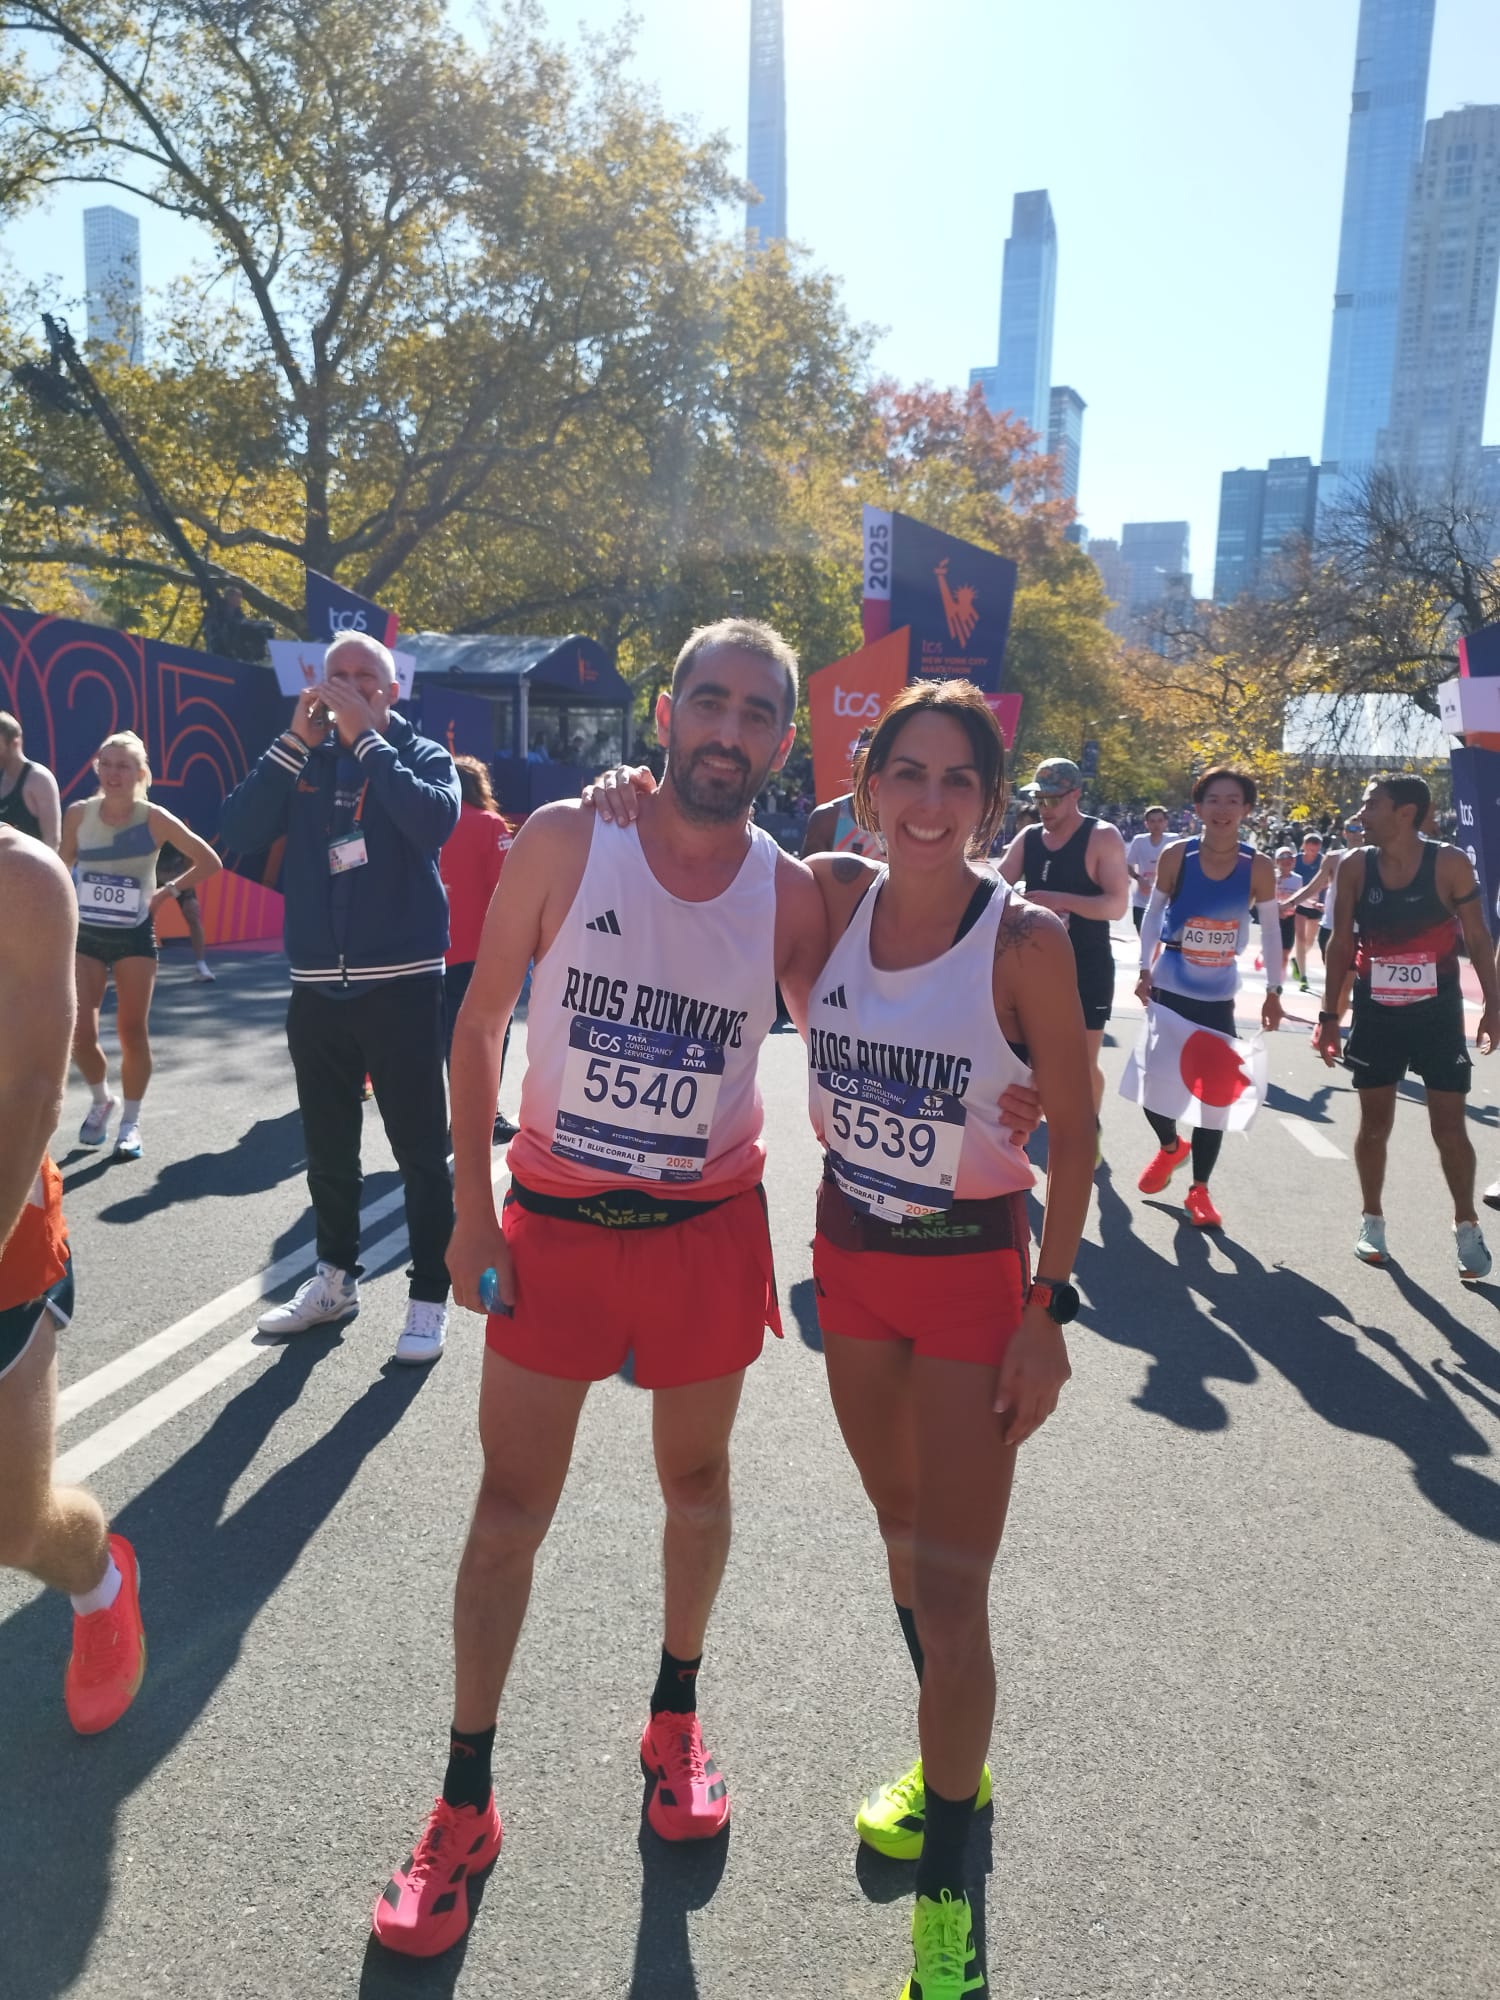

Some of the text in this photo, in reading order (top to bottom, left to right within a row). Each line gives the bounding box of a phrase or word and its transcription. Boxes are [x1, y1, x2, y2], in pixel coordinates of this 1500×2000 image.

[868, 524, 889, 590] 2025
[329, 607, 367, 632] tcs
[833, 685, 881, 718] tcs
[1460, 799, 1474, 826] tcs
[94, 886, 126, 904] 608
[1185, 930, 1235, 945] AG 1970
[1387, 965, 1422, 983] 730
[561, 966, 748, 1049] RIOS RUNNING
[588, 1026, 623, 1053] tcs
[624, 1042, 673, 1056] CONSULTANCY
[627, 1034, 647, 1044] TATA
[624, 1049, 655, 1061] SERVICES
[682, 1058, 706, 1068] TATA
[810, 1027, 972, 1099] RIOS RUNNING
[583, 1057, 698, 1119] 5540
[863, 1077, 882, 1088] TATA
[862, 1084, 906, 1105] CONSULTANCY
[862, 1091, 890, 1106] SERVICES
[918, 1107, 944, 1117] TATA
[832, 1098, 936, 1168] 5539
[556, 1132, 646, 1163] WAVE 1 BLUE CORRAL B
[666, 1156, 694, 1169] 2025
[837, 1178, 885, 1205] LUE CORRAL B
